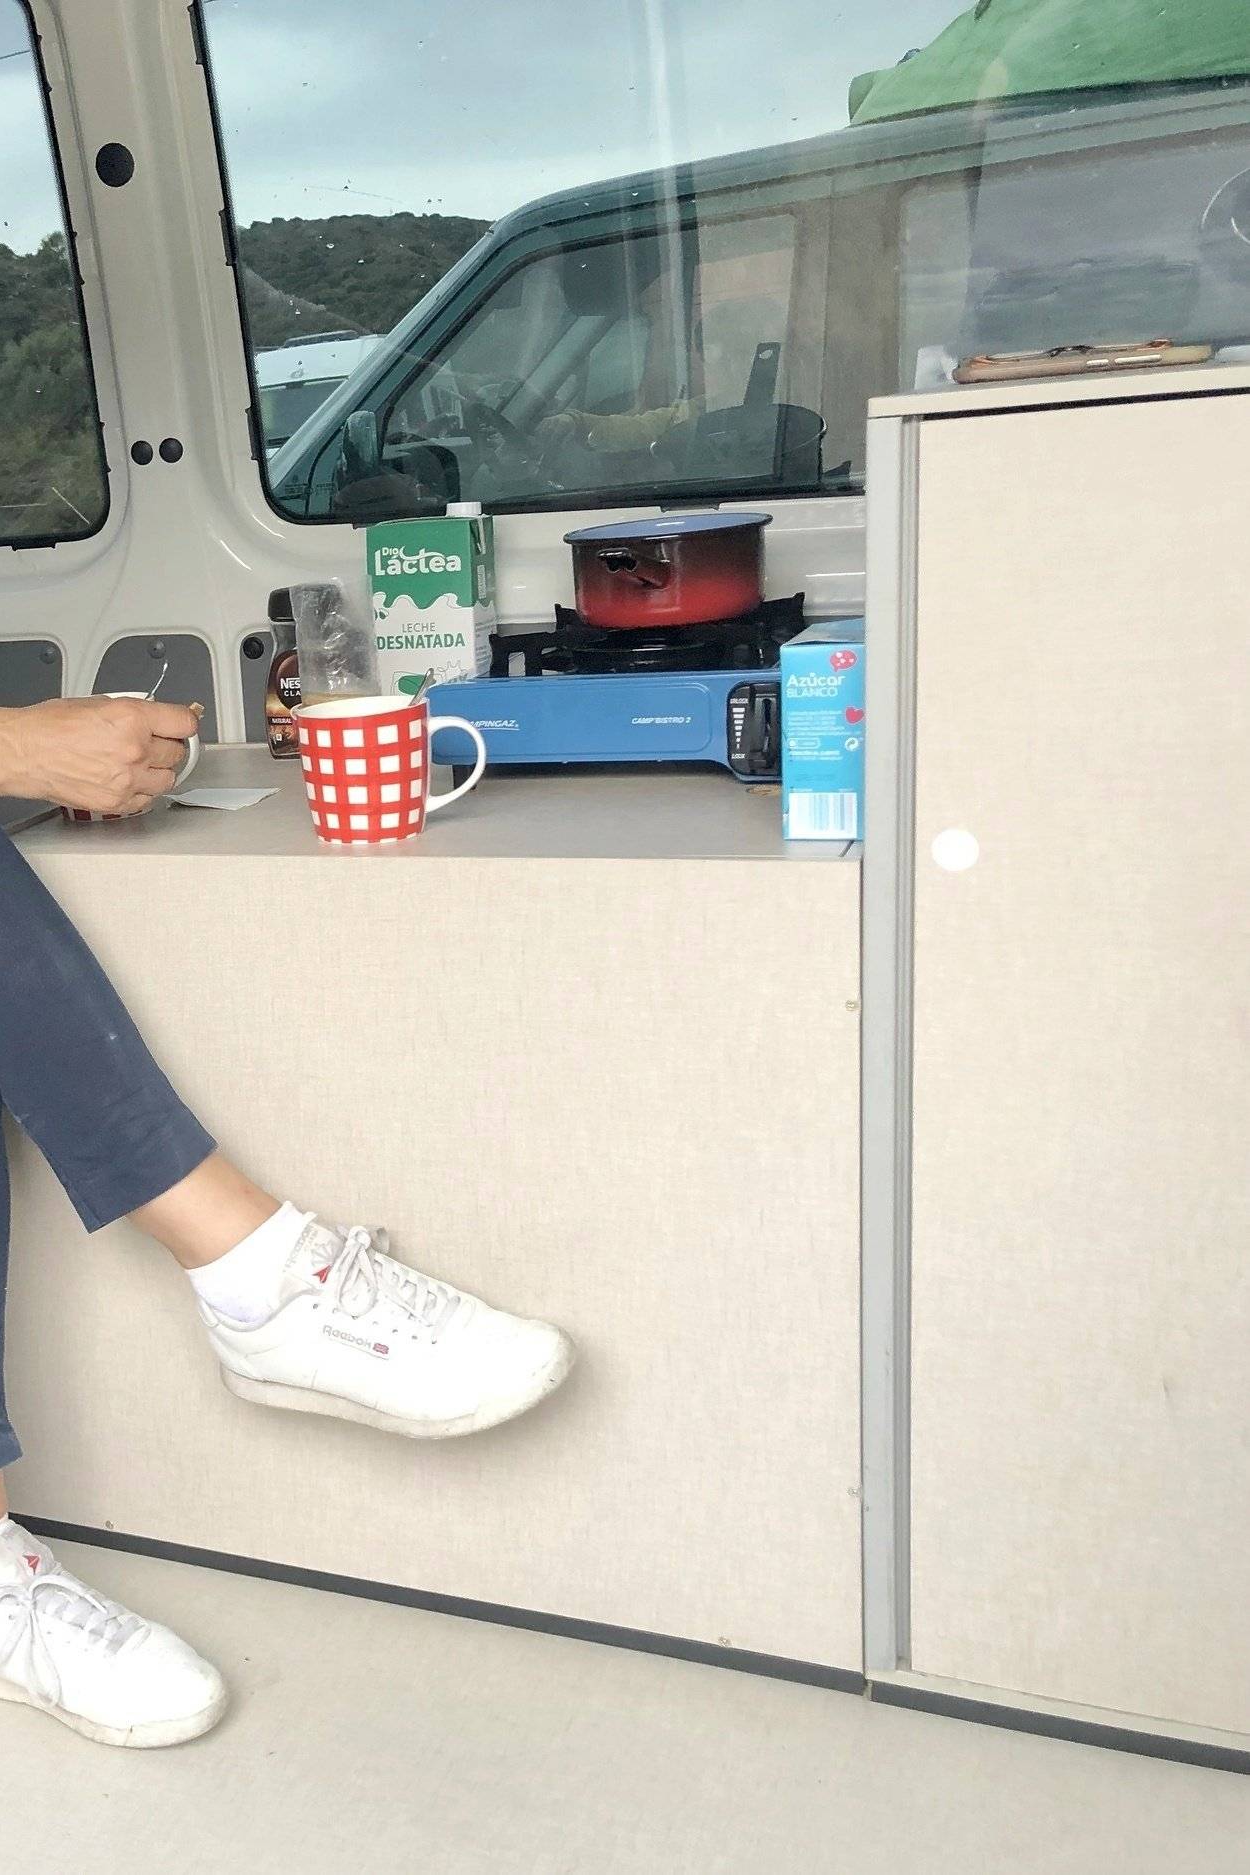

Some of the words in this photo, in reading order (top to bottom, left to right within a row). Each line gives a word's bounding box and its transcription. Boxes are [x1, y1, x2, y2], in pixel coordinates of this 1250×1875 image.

[375, 547, 461, 576] Láctea
[402, 622, 436, 633] LECHE
[376, 633, 465, 650] DESNATADA
[786, 672, 846, 687] Azúcar
[786, 687, 838, 698] BLANCO
